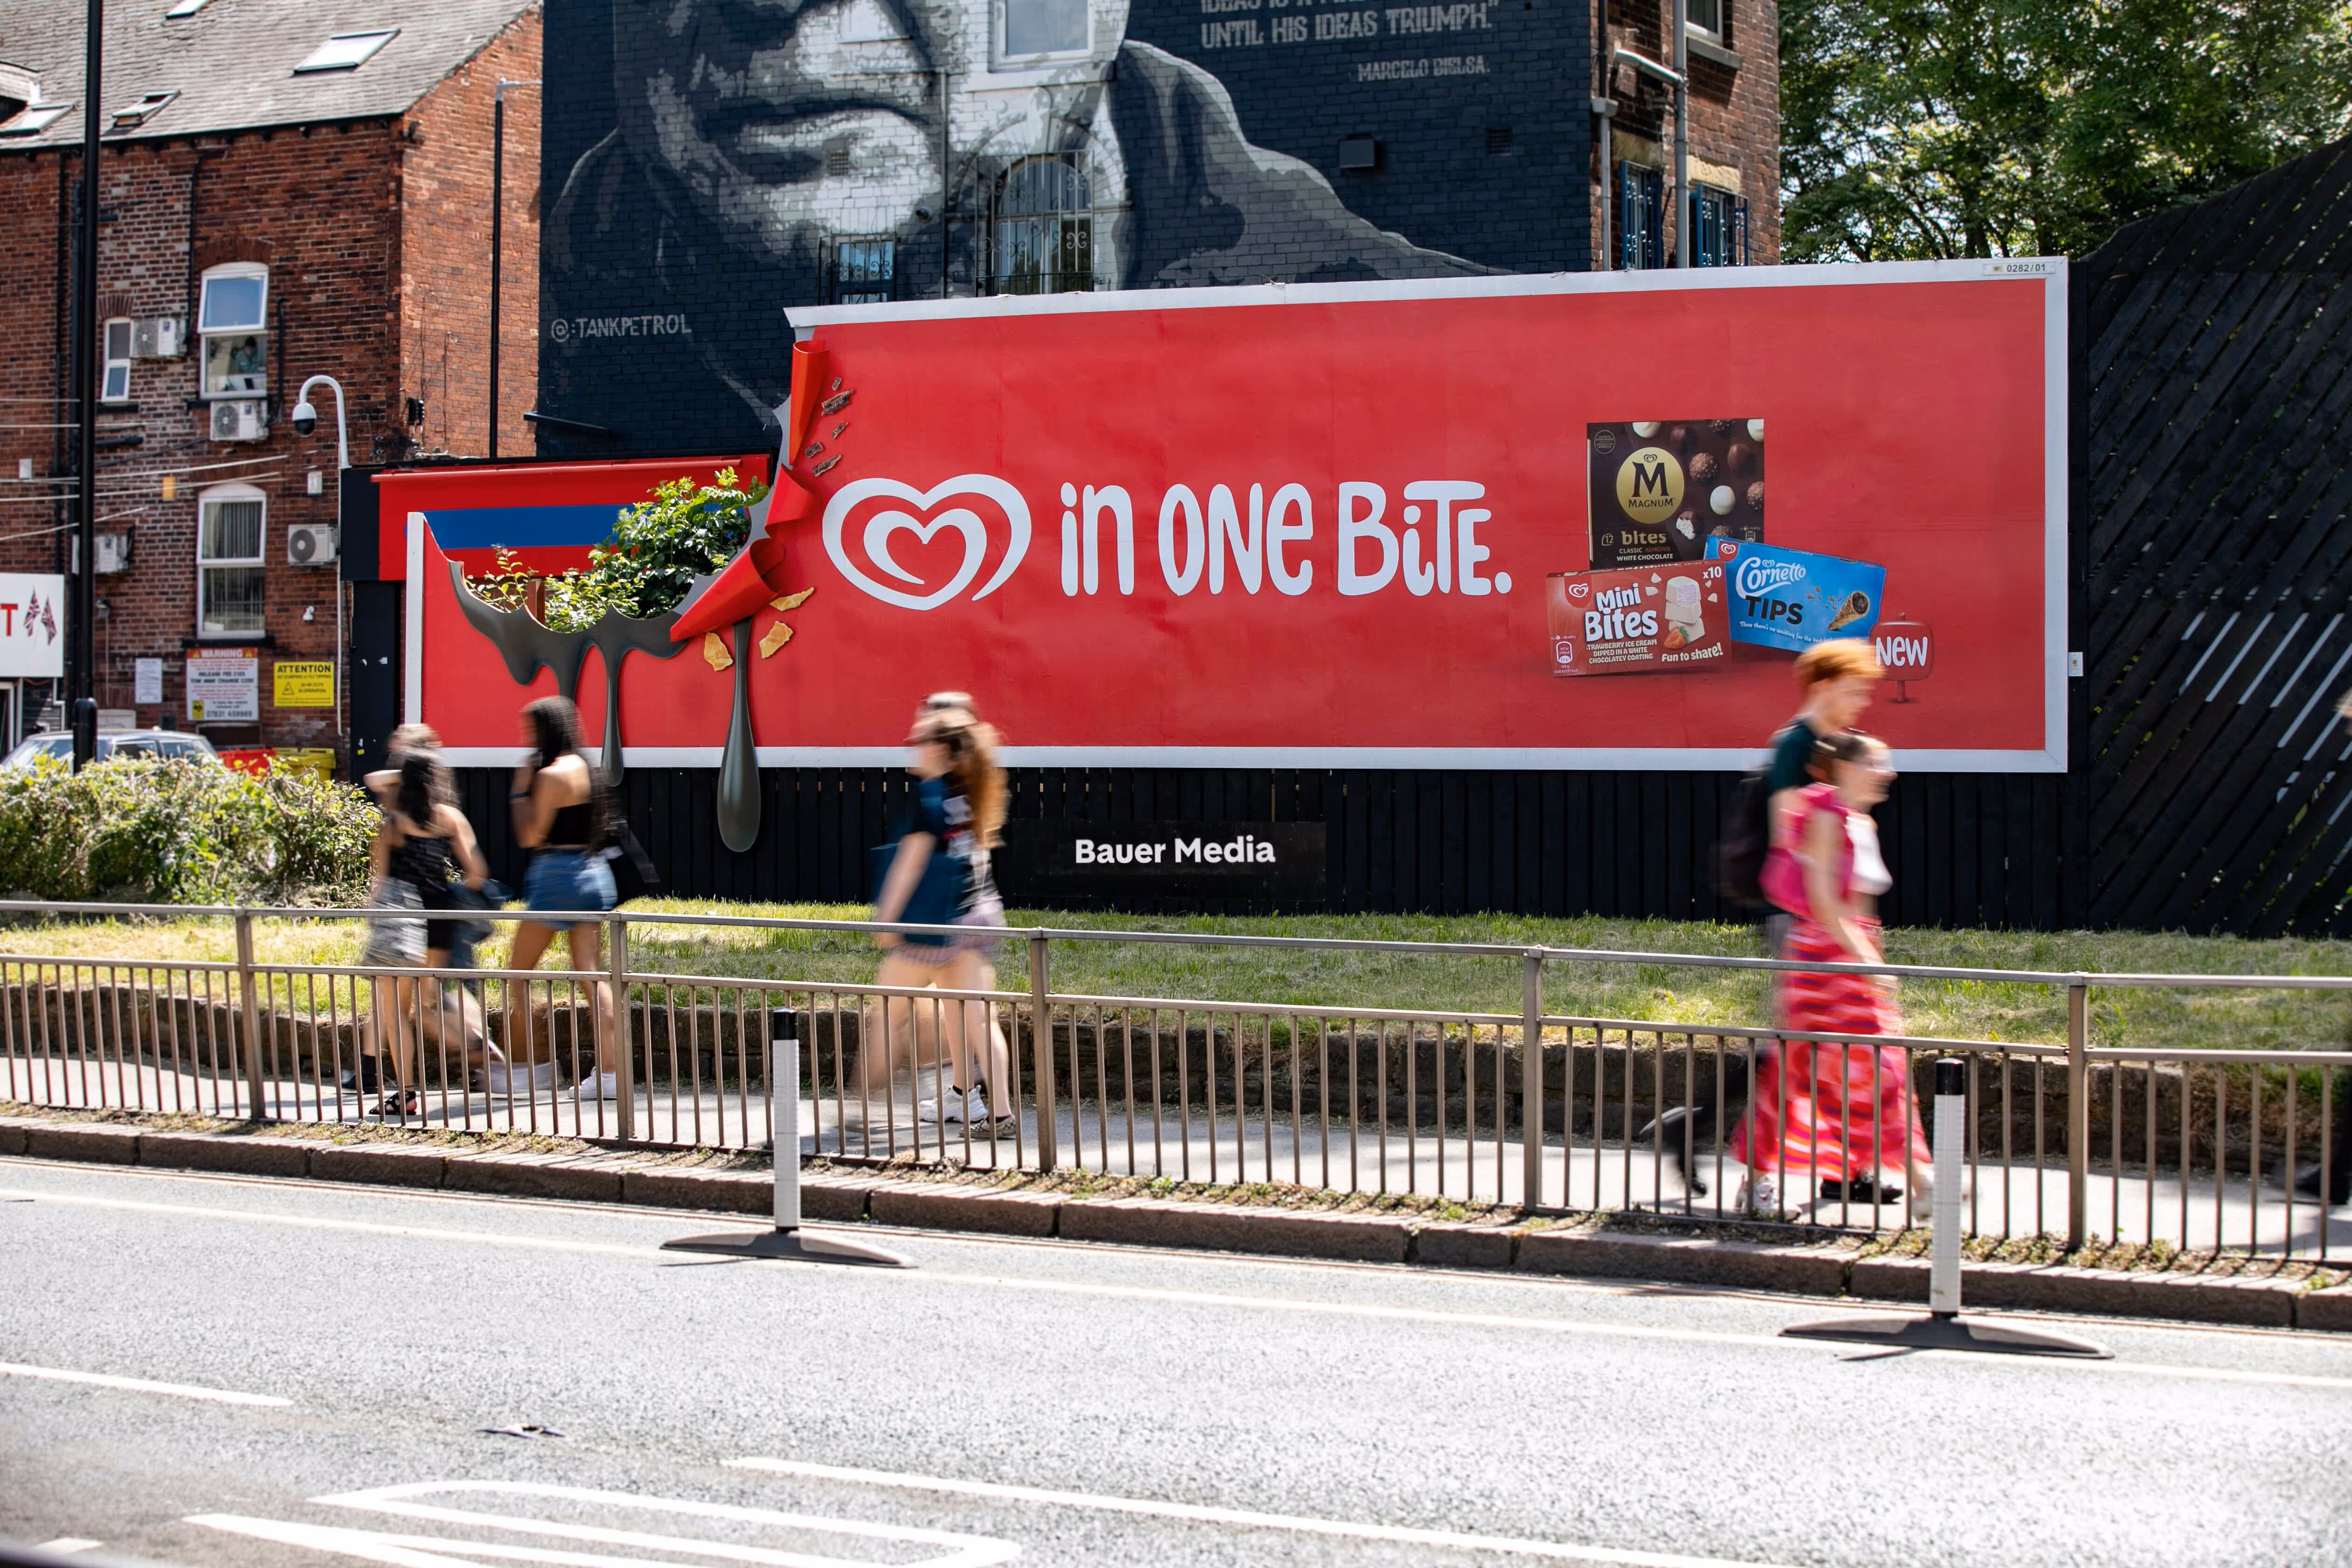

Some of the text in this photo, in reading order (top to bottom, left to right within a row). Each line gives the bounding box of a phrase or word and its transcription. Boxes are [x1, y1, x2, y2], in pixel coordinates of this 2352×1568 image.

[1201, 20, 1264, 49] UNTIL
[1272, 16, 1307, 43] HIS
[1315, 10, 1378, 40] IDEAS
[1358, 59, 1429, 82] MARCELO
[2007, 264, 2045, 273] 0282/01
[1605, 535, 1614, 544] 12
[1621, 531, 1667, 546] bites
[1703, 566, 1722, 579] x10
[1735, 557, 1806, 600] Cornetto
[1596, 582, 1641, 612] Mini
[0, 603, 18, 637] T
[1745, 595, 1804, 625] TIPS
[1585, 607, 1659, 642] Bites
[1777, 629, 1795, 639] waiting
[201, 649, 243, 658] WARNING
[1661, 642, 1724, 662] Fun to share!
[1075, 834, 1276, 864] Bauer Media
